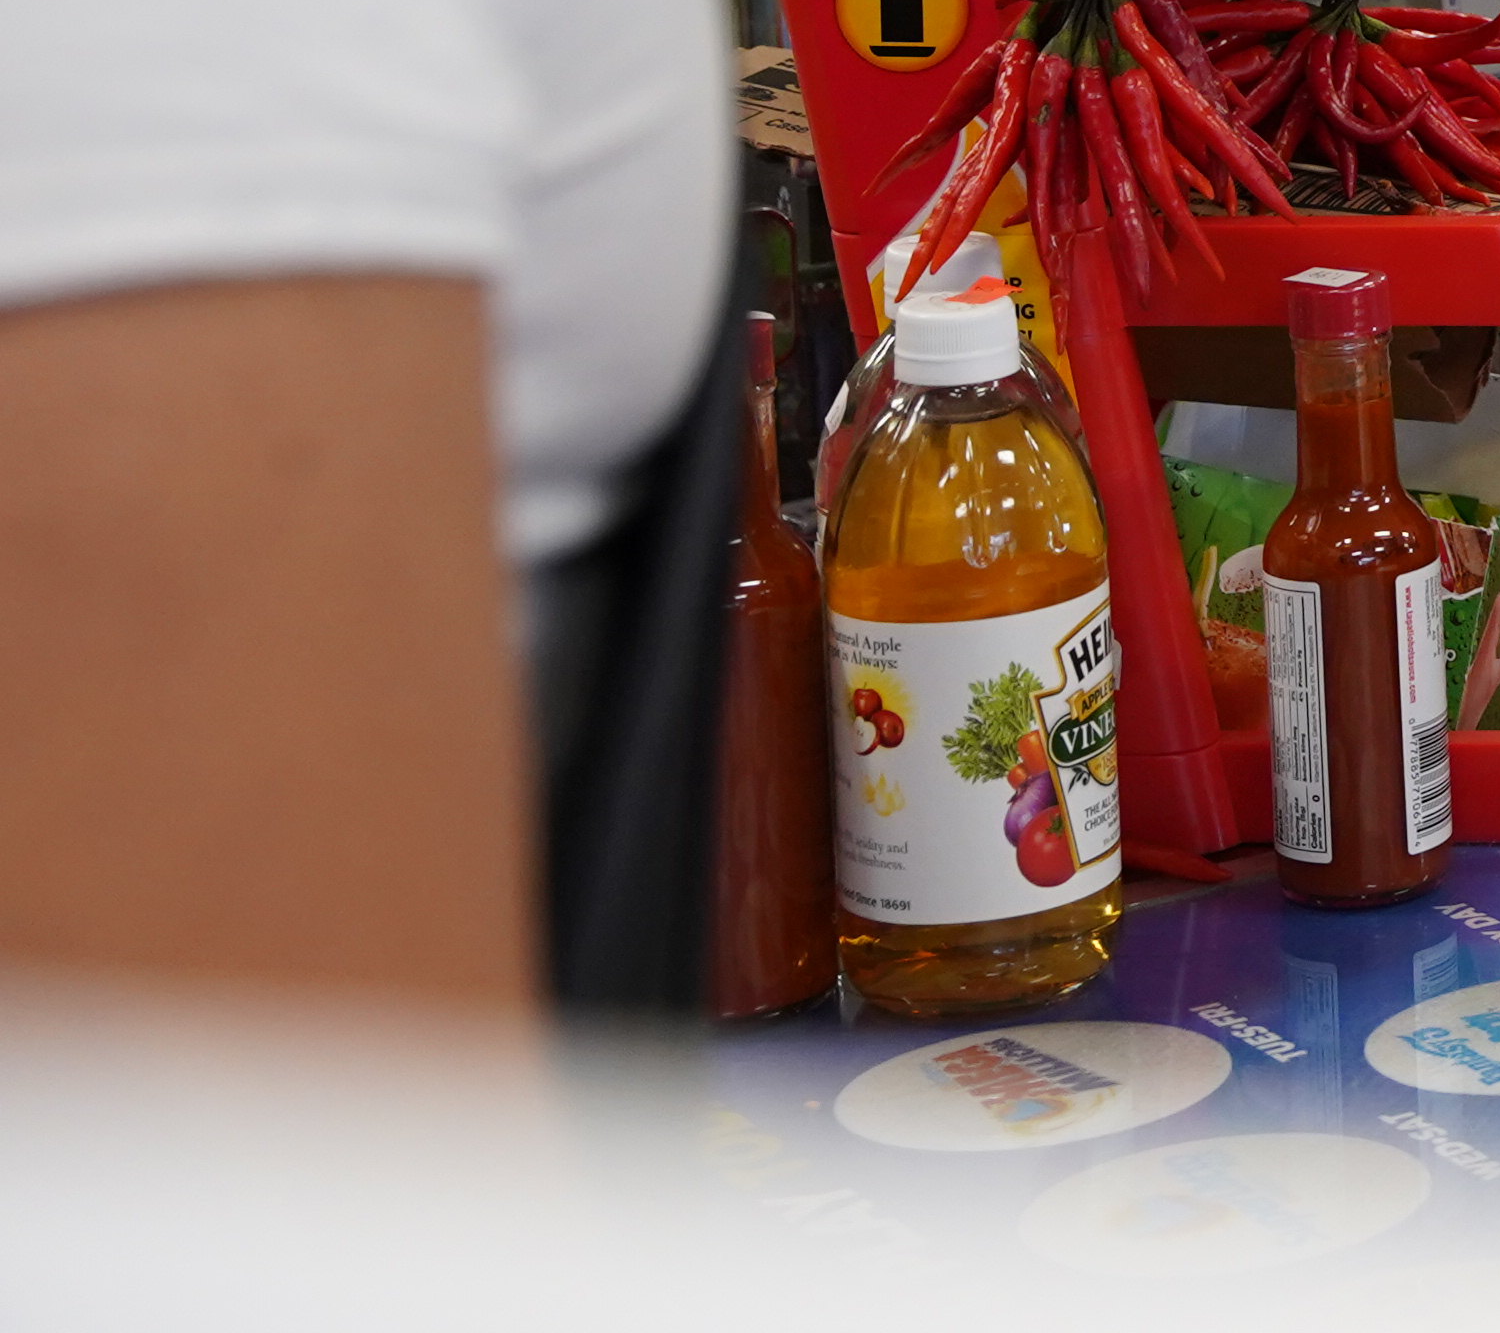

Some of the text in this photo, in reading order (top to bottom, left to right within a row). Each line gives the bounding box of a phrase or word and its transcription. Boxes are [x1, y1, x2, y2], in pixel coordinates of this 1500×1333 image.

[863, 636, 902, 656] Apple
[851, 650, 898, 673] Always:
[1081, 679, 1109, 714] APPLE
[1409, 739, 1420, 780] 77885
[1413, 786, 1421, 826] 71061
[887, 841, 908, 854] and
[1432, 902, 1500, 931] DAY
